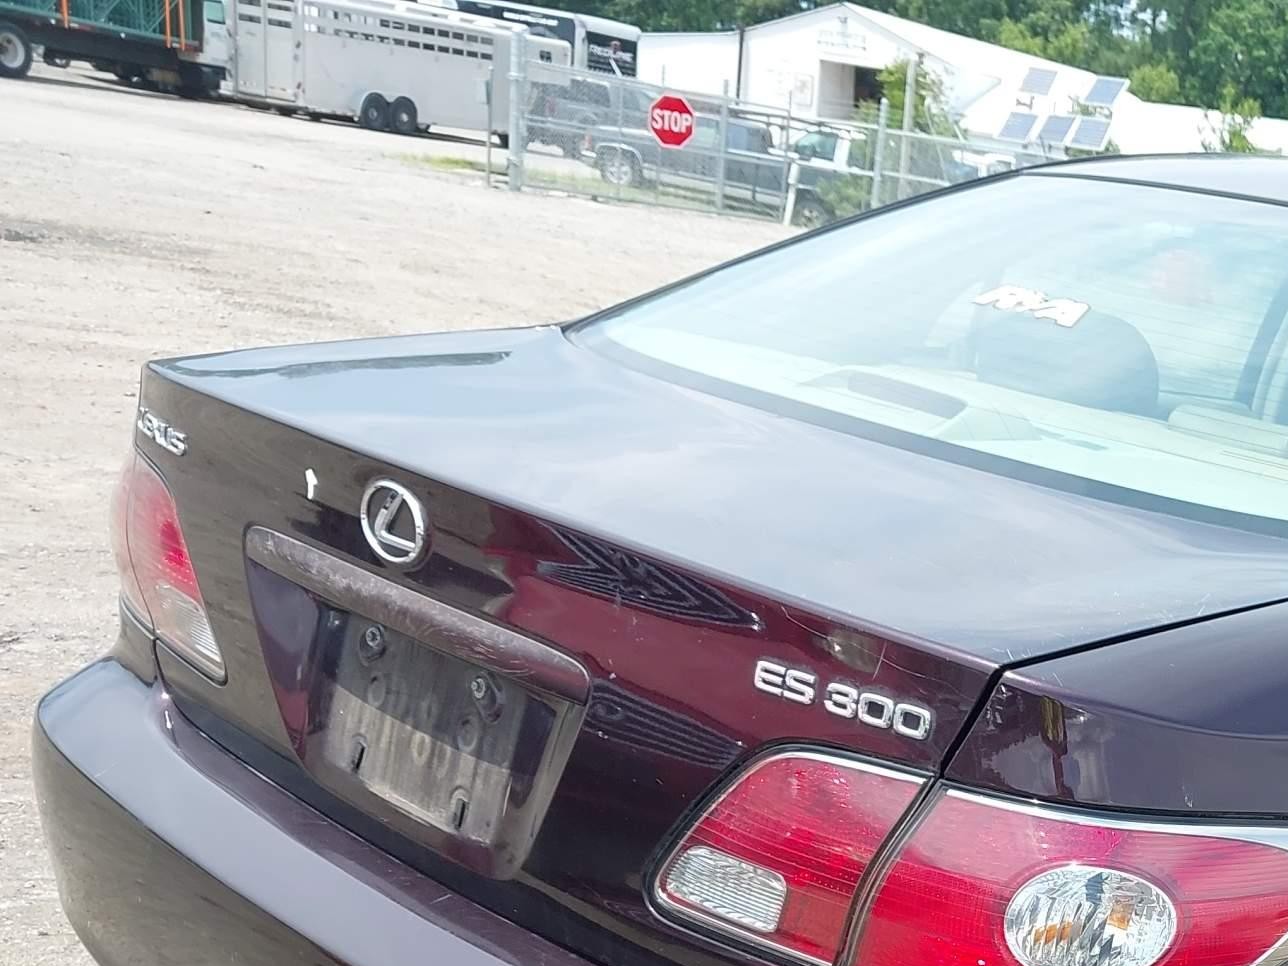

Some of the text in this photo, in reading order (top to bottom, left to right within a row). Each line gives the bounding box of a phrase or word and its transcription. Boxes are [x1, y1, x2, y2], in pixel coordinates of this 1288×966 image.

[651, 108, 692, 133] STOP
[754, 660, 931, 741] ES 300
